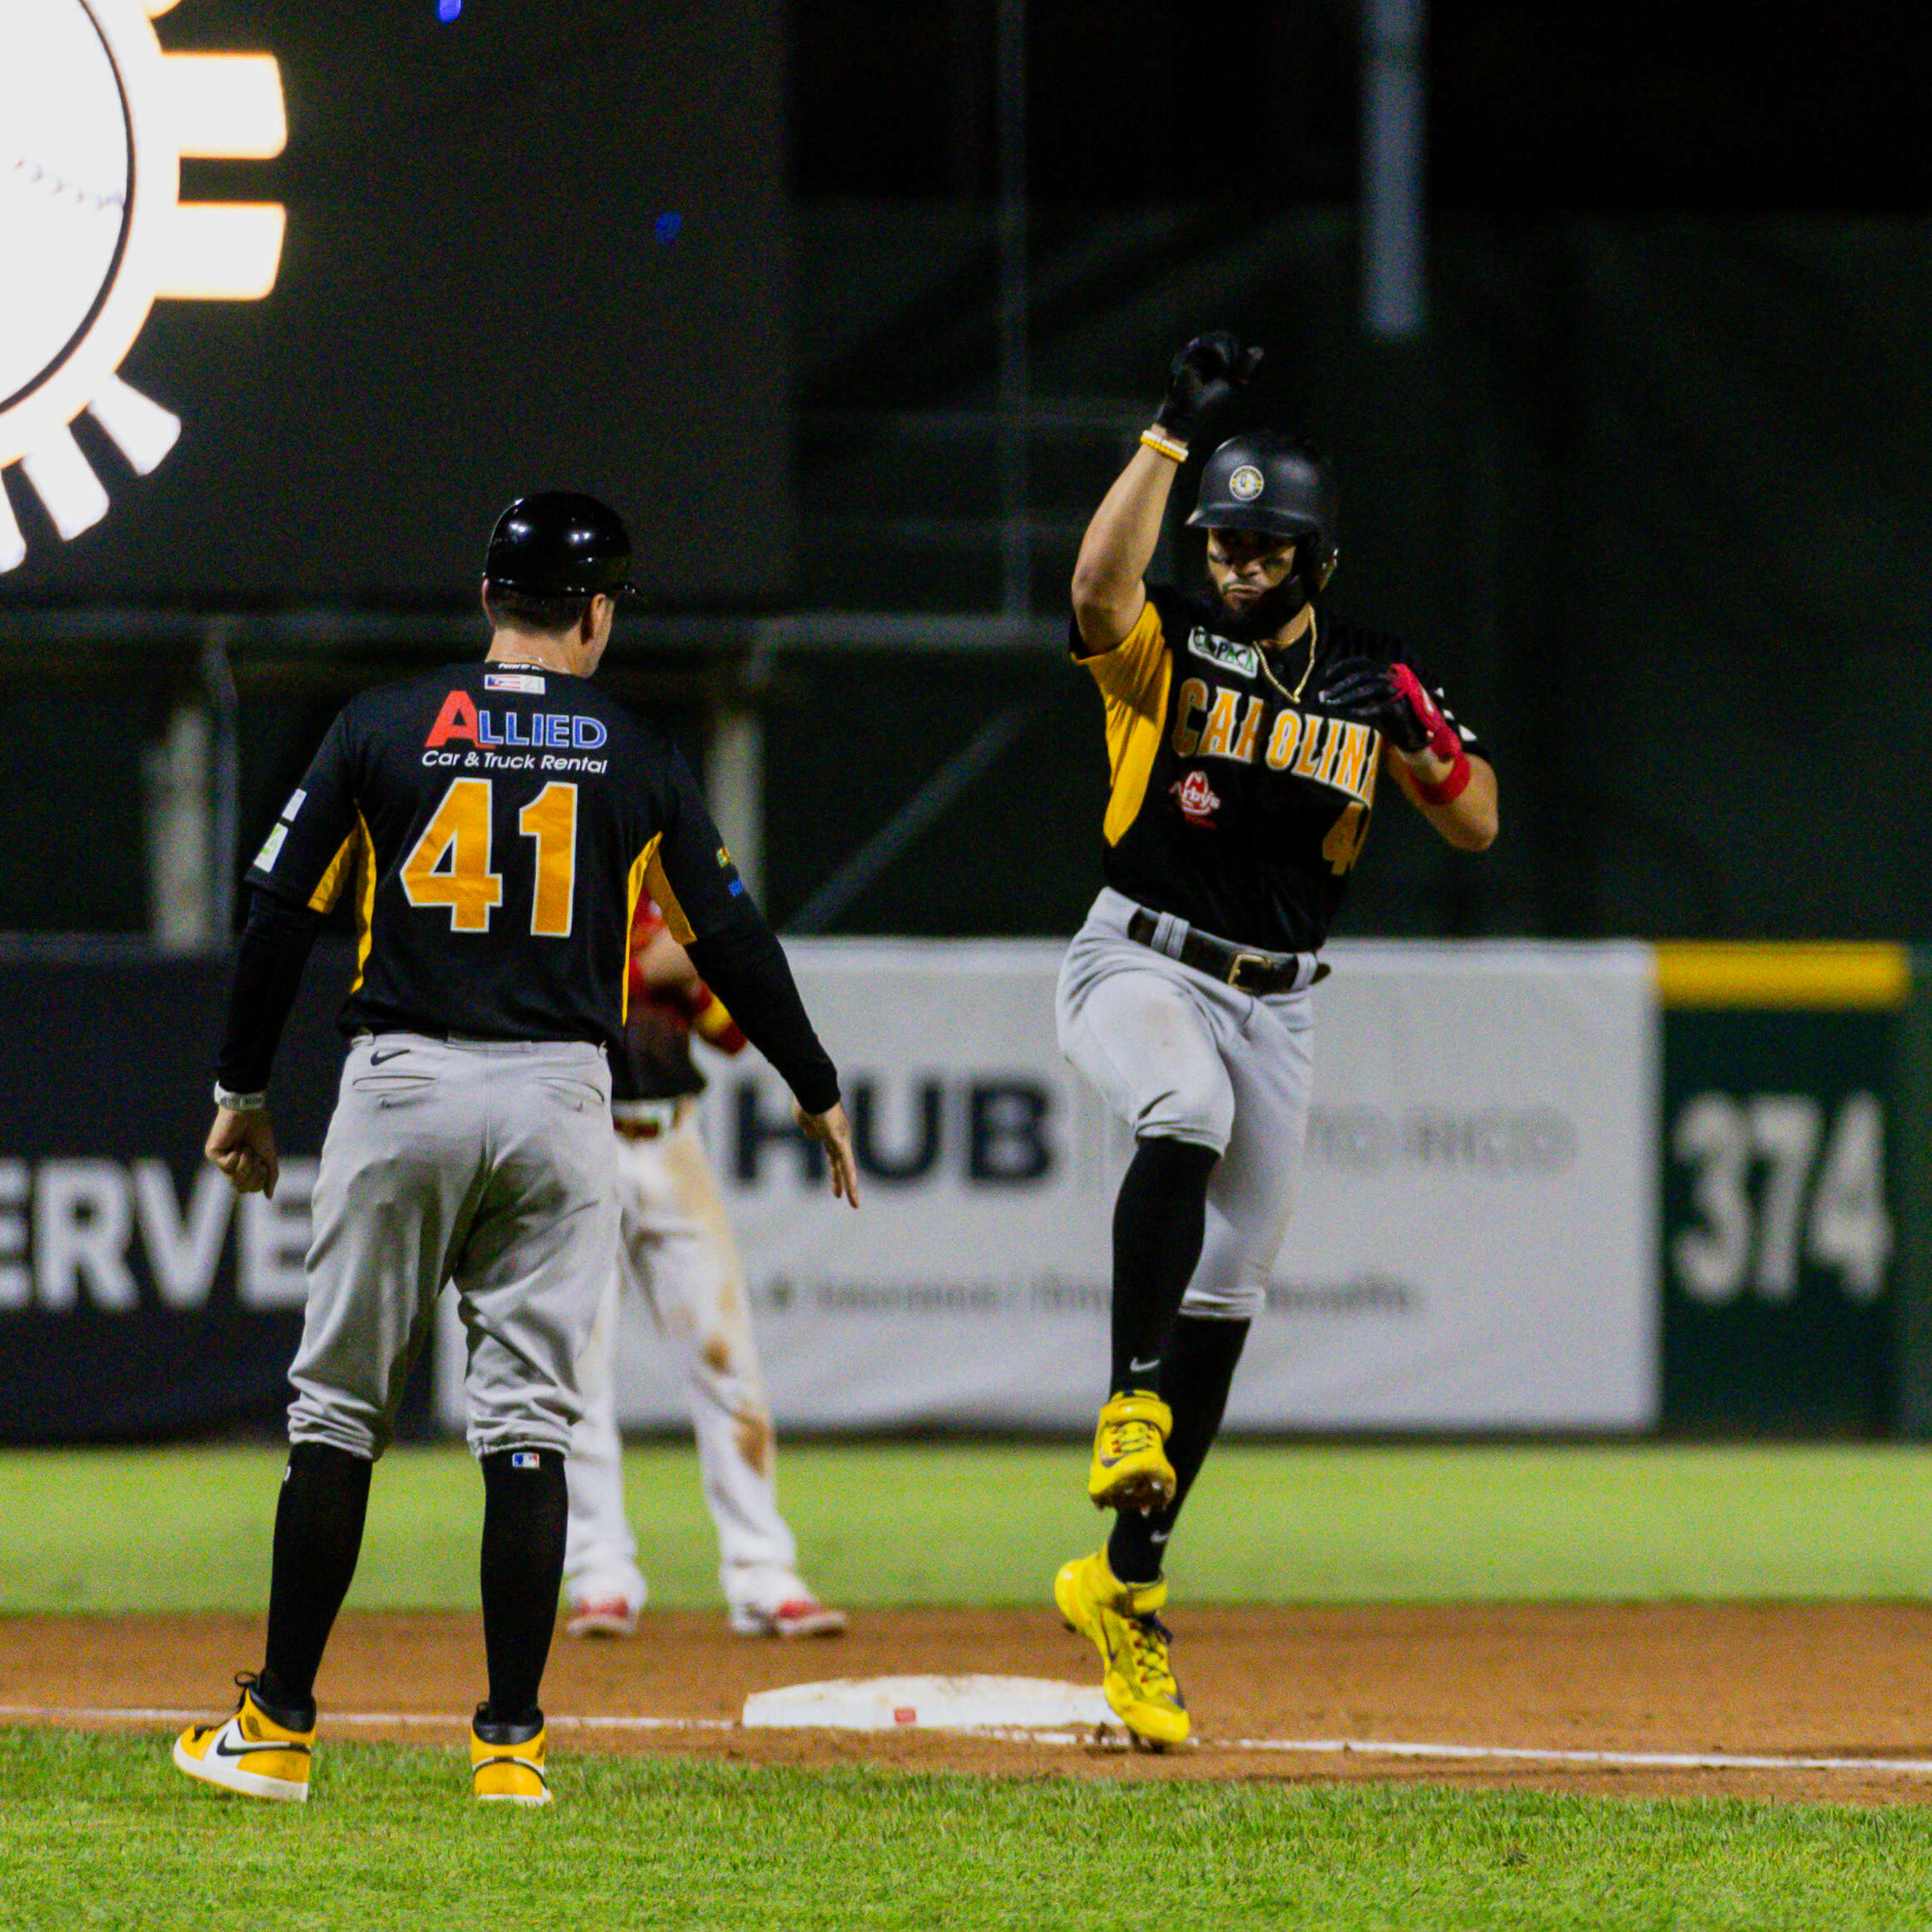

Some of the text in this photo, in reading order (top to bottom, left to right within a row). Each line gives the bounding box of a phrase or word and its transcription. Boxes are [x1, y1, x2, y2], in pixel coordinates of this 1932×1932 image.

[421, 750, 608, 774] Car & Truck Rental
[424, 690, 608, 749] ALLIED
[400, 776, 579, 938] 41
[1322, 800, 1372, 875] 4
[734, 1073, 1060, 1188] HUB
[1672, 1091, 1893, 1302] 374
